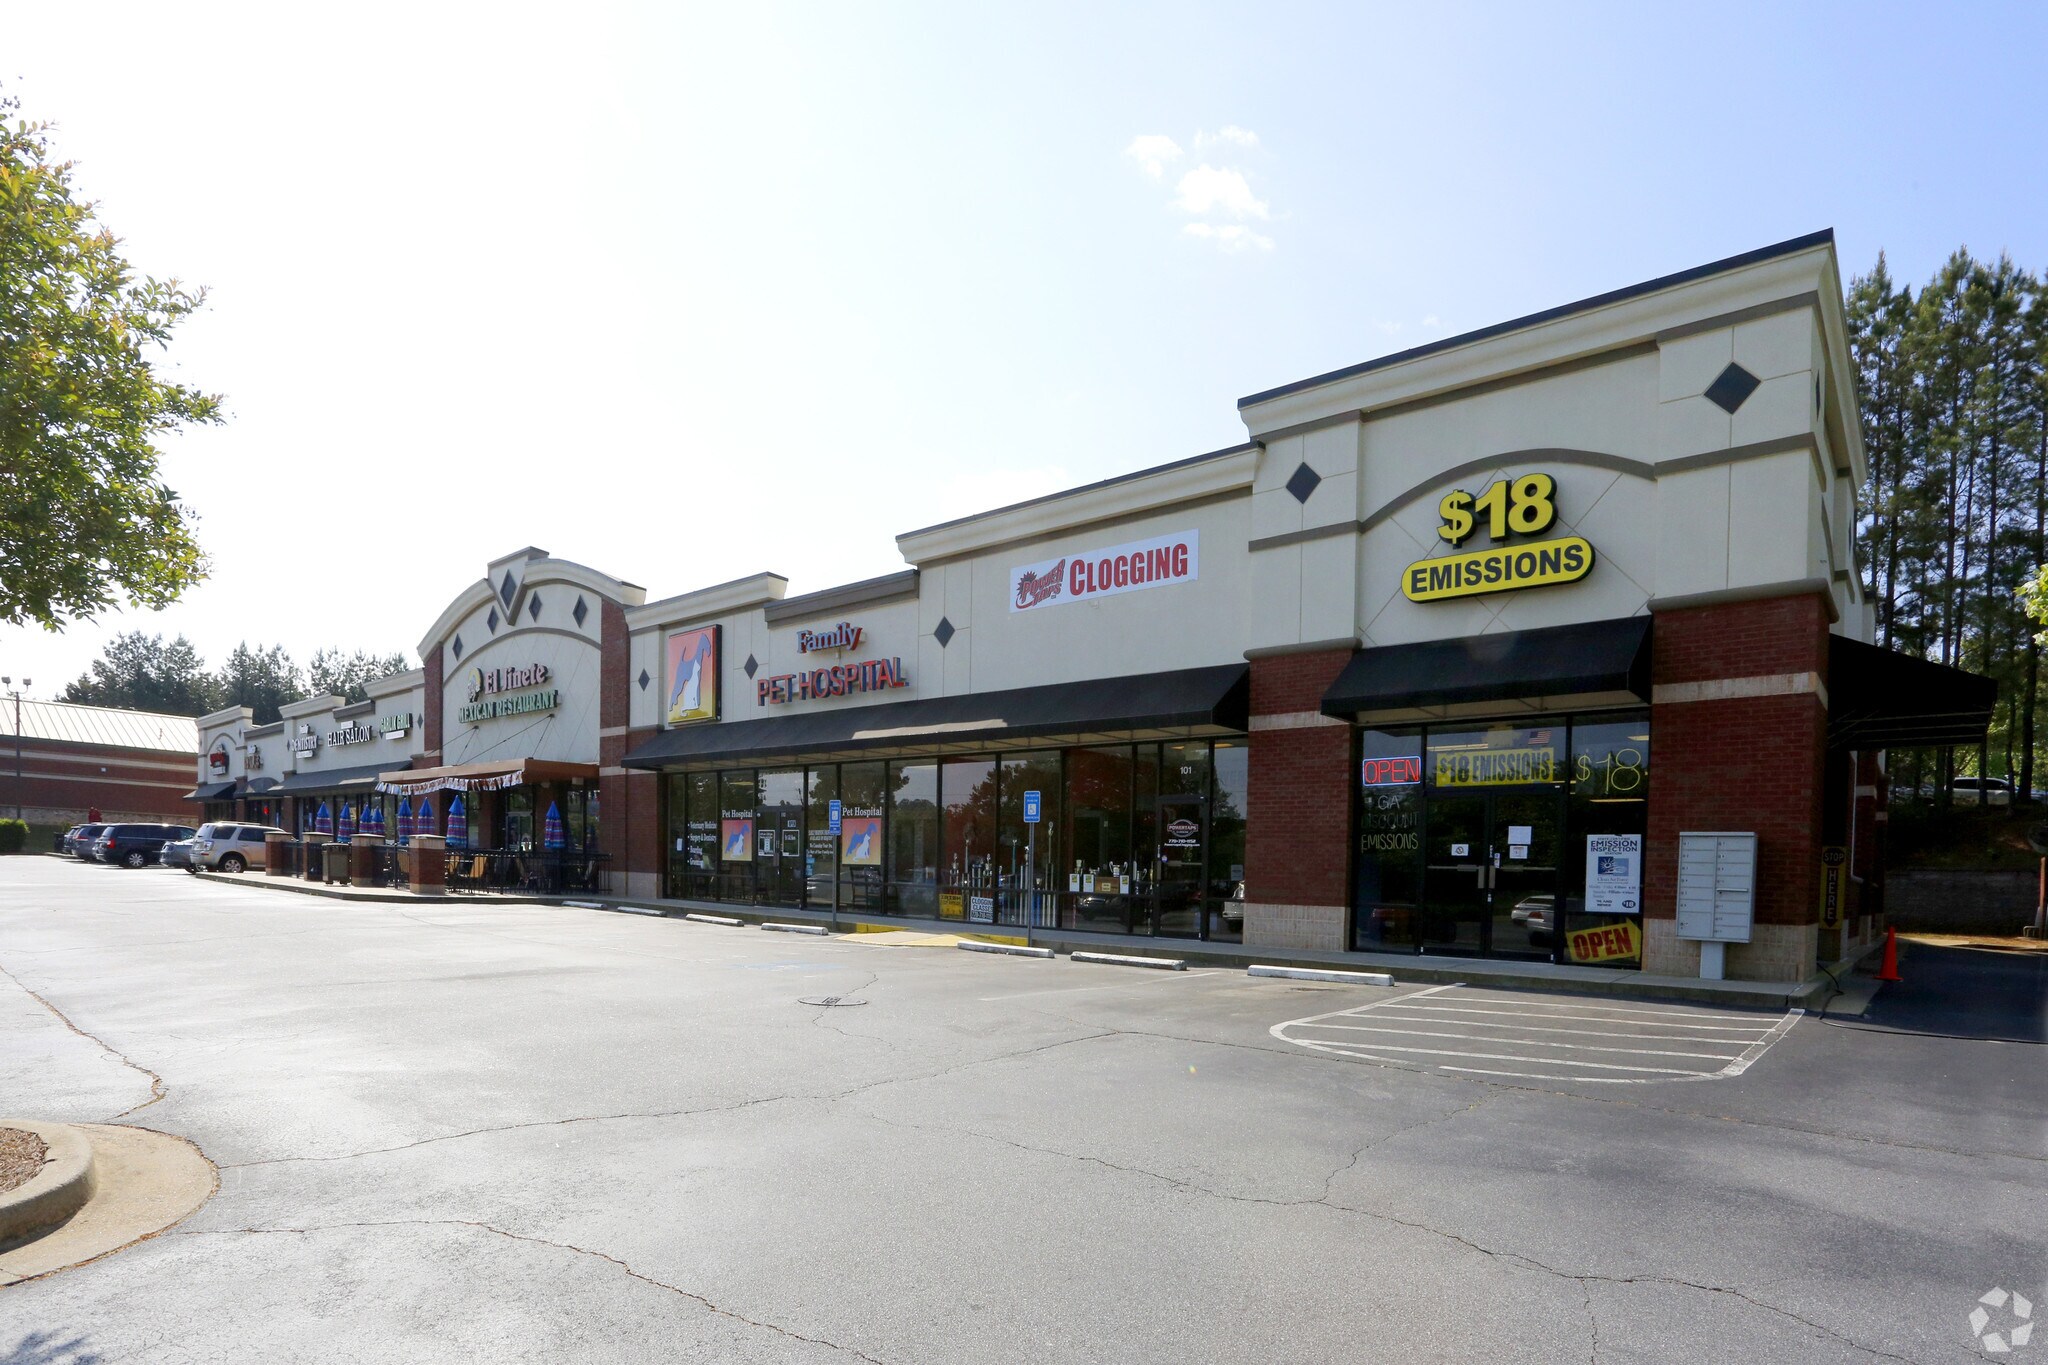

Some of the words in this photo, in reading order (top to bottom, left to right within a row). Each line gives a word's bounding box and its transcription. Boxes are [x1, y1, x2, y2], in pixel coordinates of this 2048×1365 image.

[1437, 473, 1557, 547] $18
[1069, 543, 1188, 596] CLOGGING
[1411, 544, 1584, 594] EMISSIONS
[796, 621, 863, 653] Family
[485, 669, 500, 694] El
[502, 663, 548, 691] Jinete
[758, 673, 796, 706] PET
[799, 656, 909, 700] HOSPITAL
[459, 701, 495, 724] MEXICAN
[496, 689, 558, 717] RESTAURANT
[327, 731, 345, 747] HAIR
[345, 725, 372, 745] SALON
[1180, 766, 1192, 774] 101
[1364, 759, 1420, 783] OPEN
[1439, 753, 1470, 783] $18
[1472, 751, 1550, 782] EMISSIONS
[1576, 748, 1641, 794] $18
[721, 809, 731, 818] Pet
[731, 809, 753, 819] Hospital
[842, 807, 853, 816] Pet
[854, 806, 882, 817] Hospital
[1378, 794, 1400, 811] GA
[1361, 833, 1419, 851] EMISSIONS
[1824, 852, 1844, 861] STOP
[1827, 869, 1836, 919] HERE
[1573, 926, 1633, 960] OPEN
